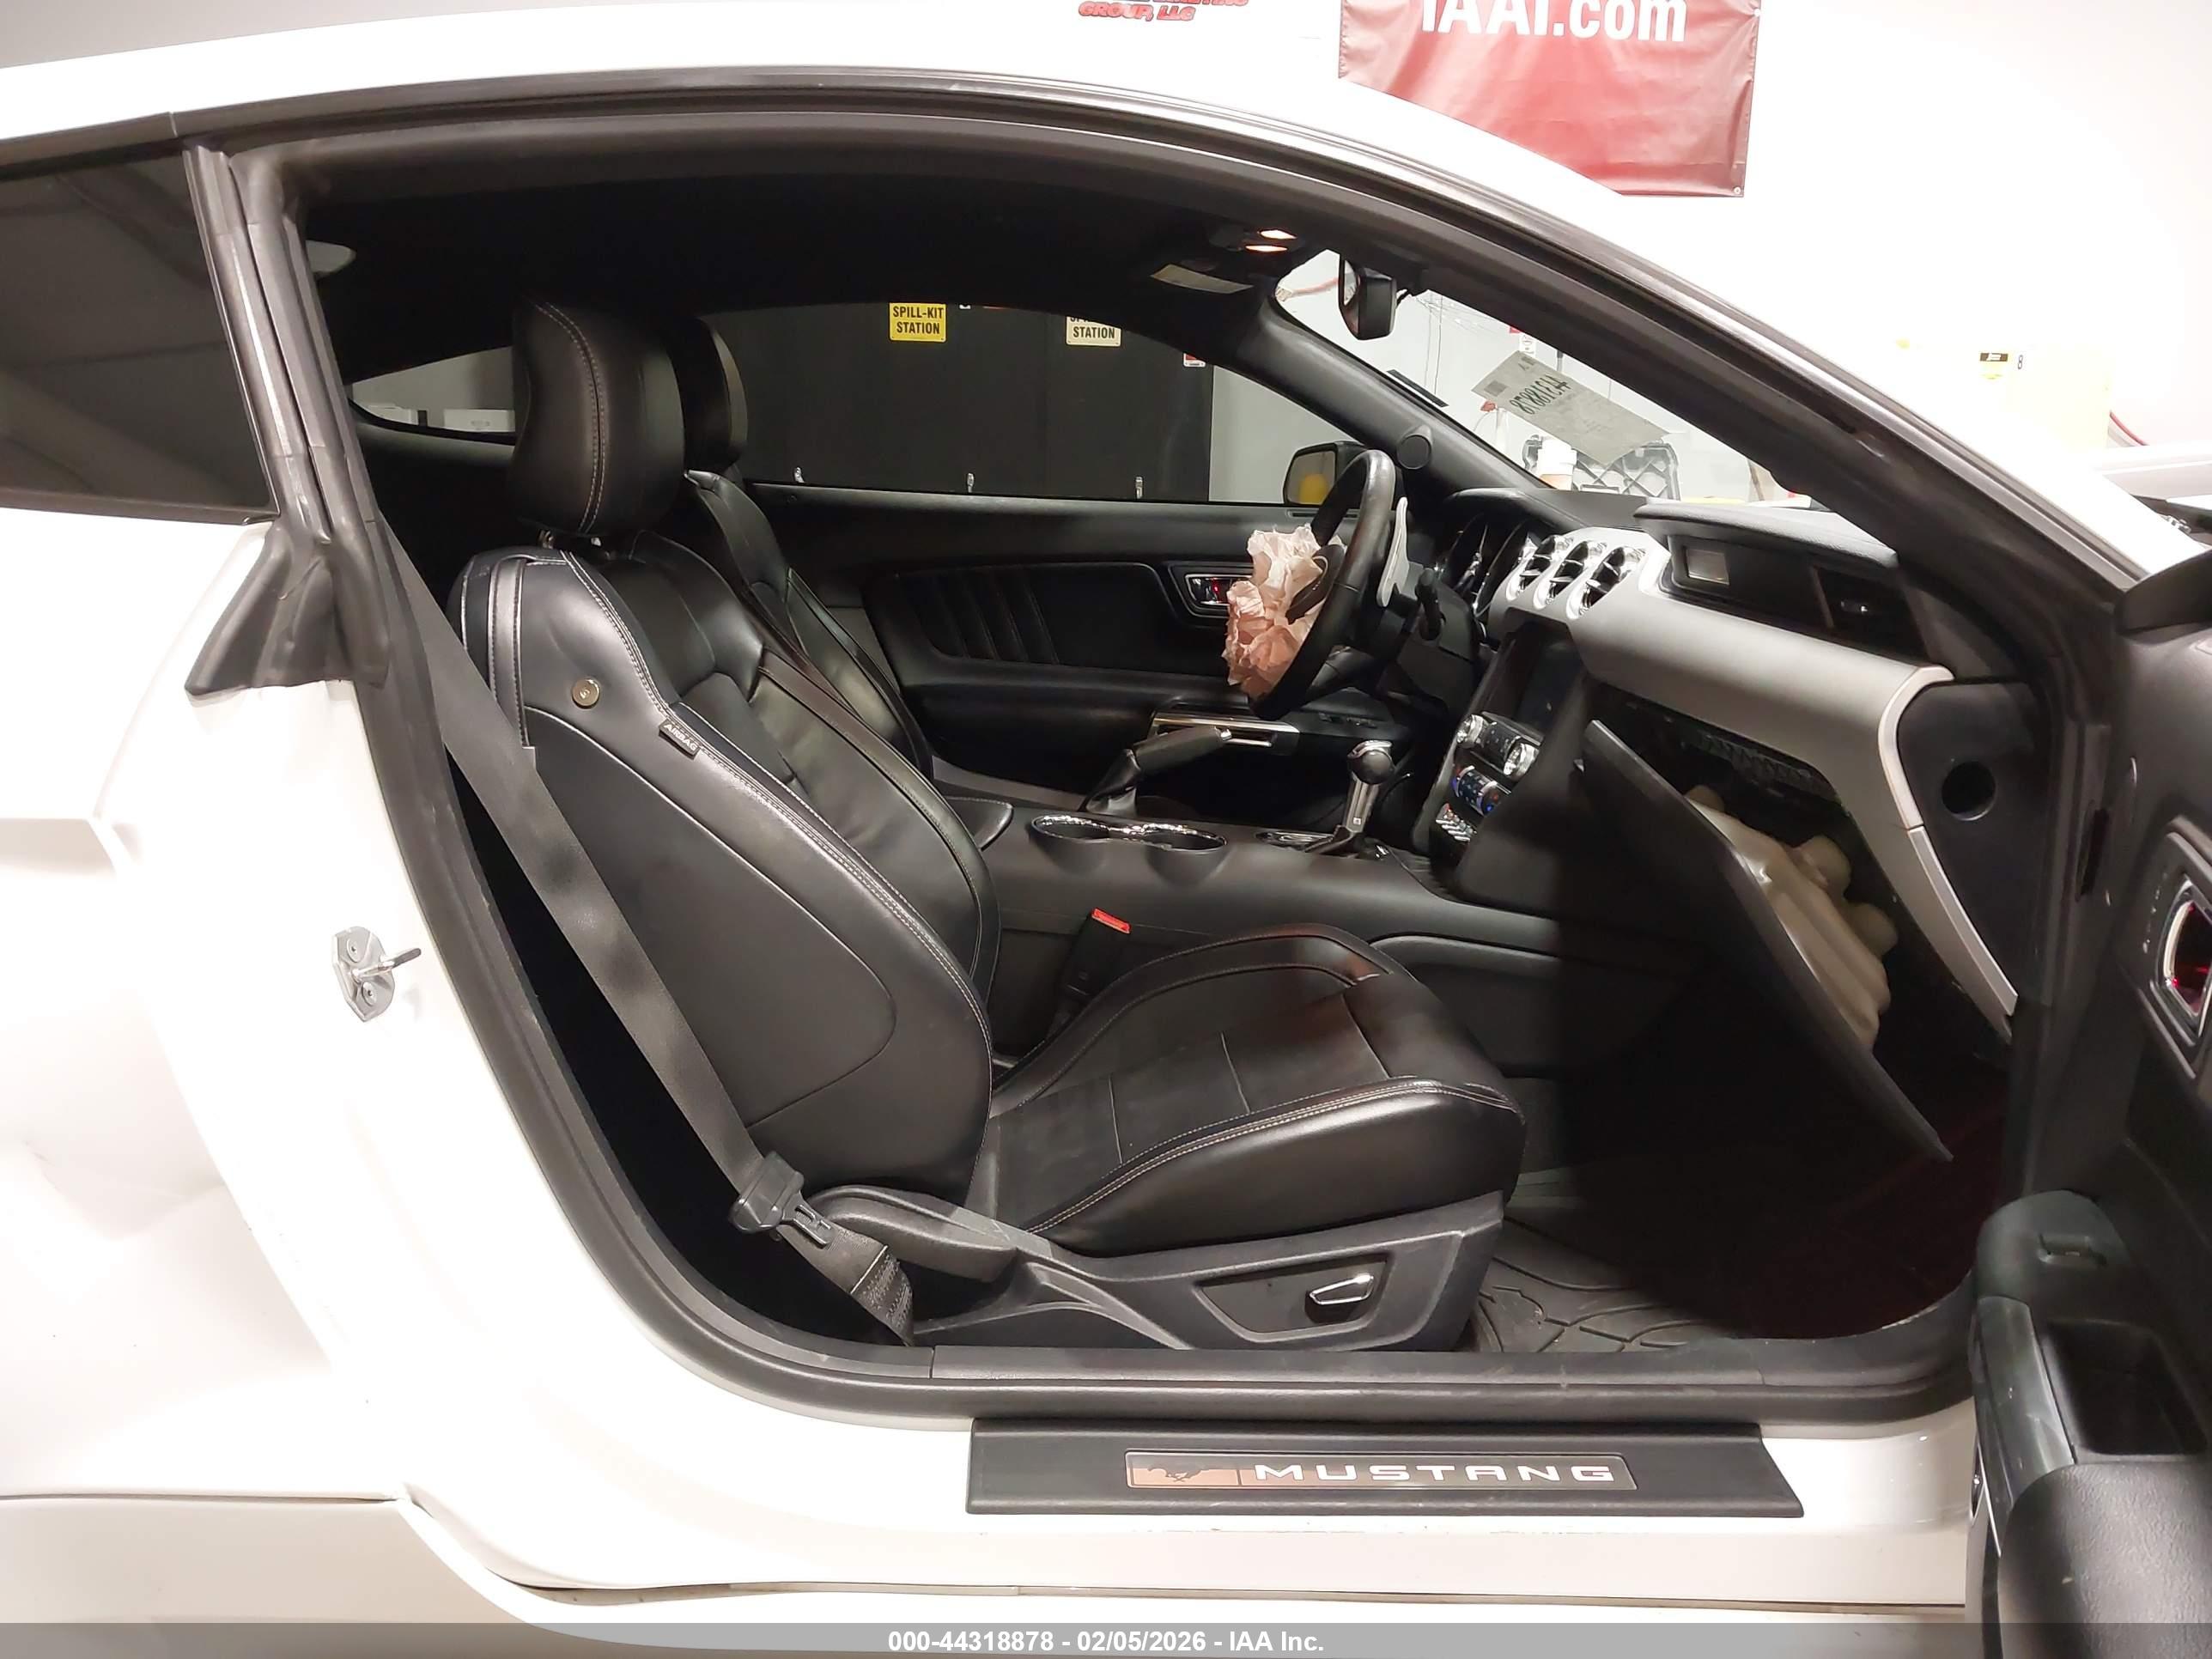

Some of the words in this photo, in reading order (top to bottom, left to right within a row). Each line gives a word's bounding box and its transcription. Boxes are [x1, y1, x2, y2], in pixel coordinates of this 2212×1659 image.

[1157, 5, 1196, 21] LLC
[893, 306, 944, 319] SPILL-KIT
[896, 321, 940, 334] STATION
[1073, 326, 1115, 339] STATION
[663, 724, 698, 751] AIRBAG
[1255, 1464, 1615, 1481] MUSTANG
